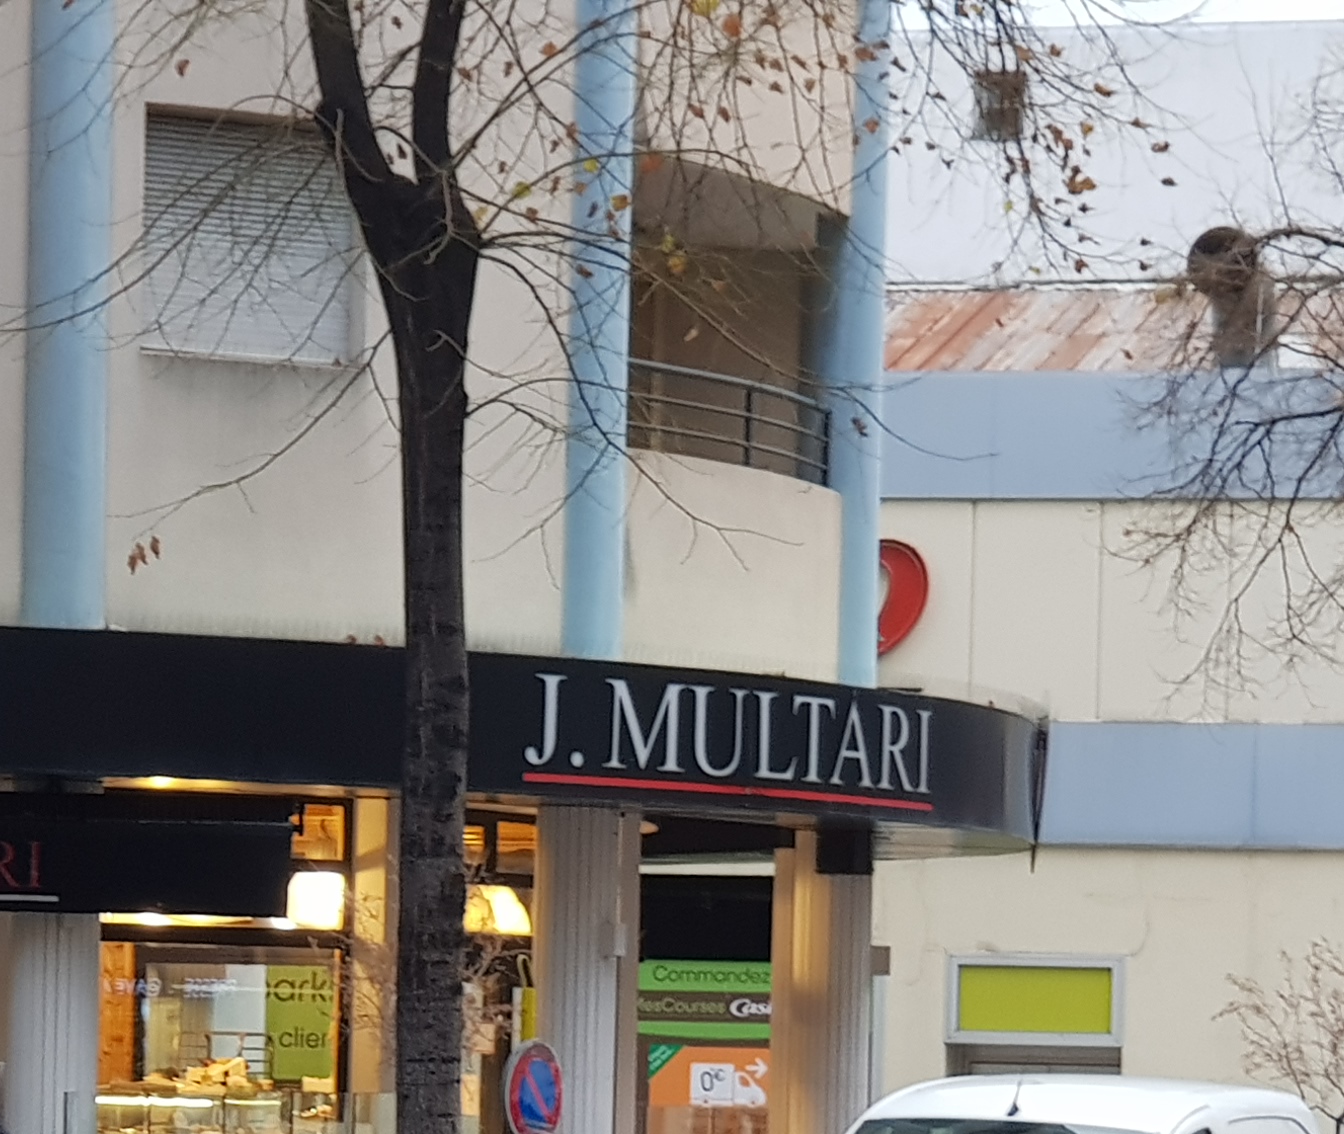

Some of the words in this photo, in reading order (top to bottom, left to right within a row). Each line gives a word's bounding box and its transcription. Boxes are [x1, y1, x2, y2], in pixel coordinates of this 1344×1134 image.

[523, 672, 585, 768] J.
[601, 677, 934, 795] MULTARI
[652, 964, 771, 985] Commandez
